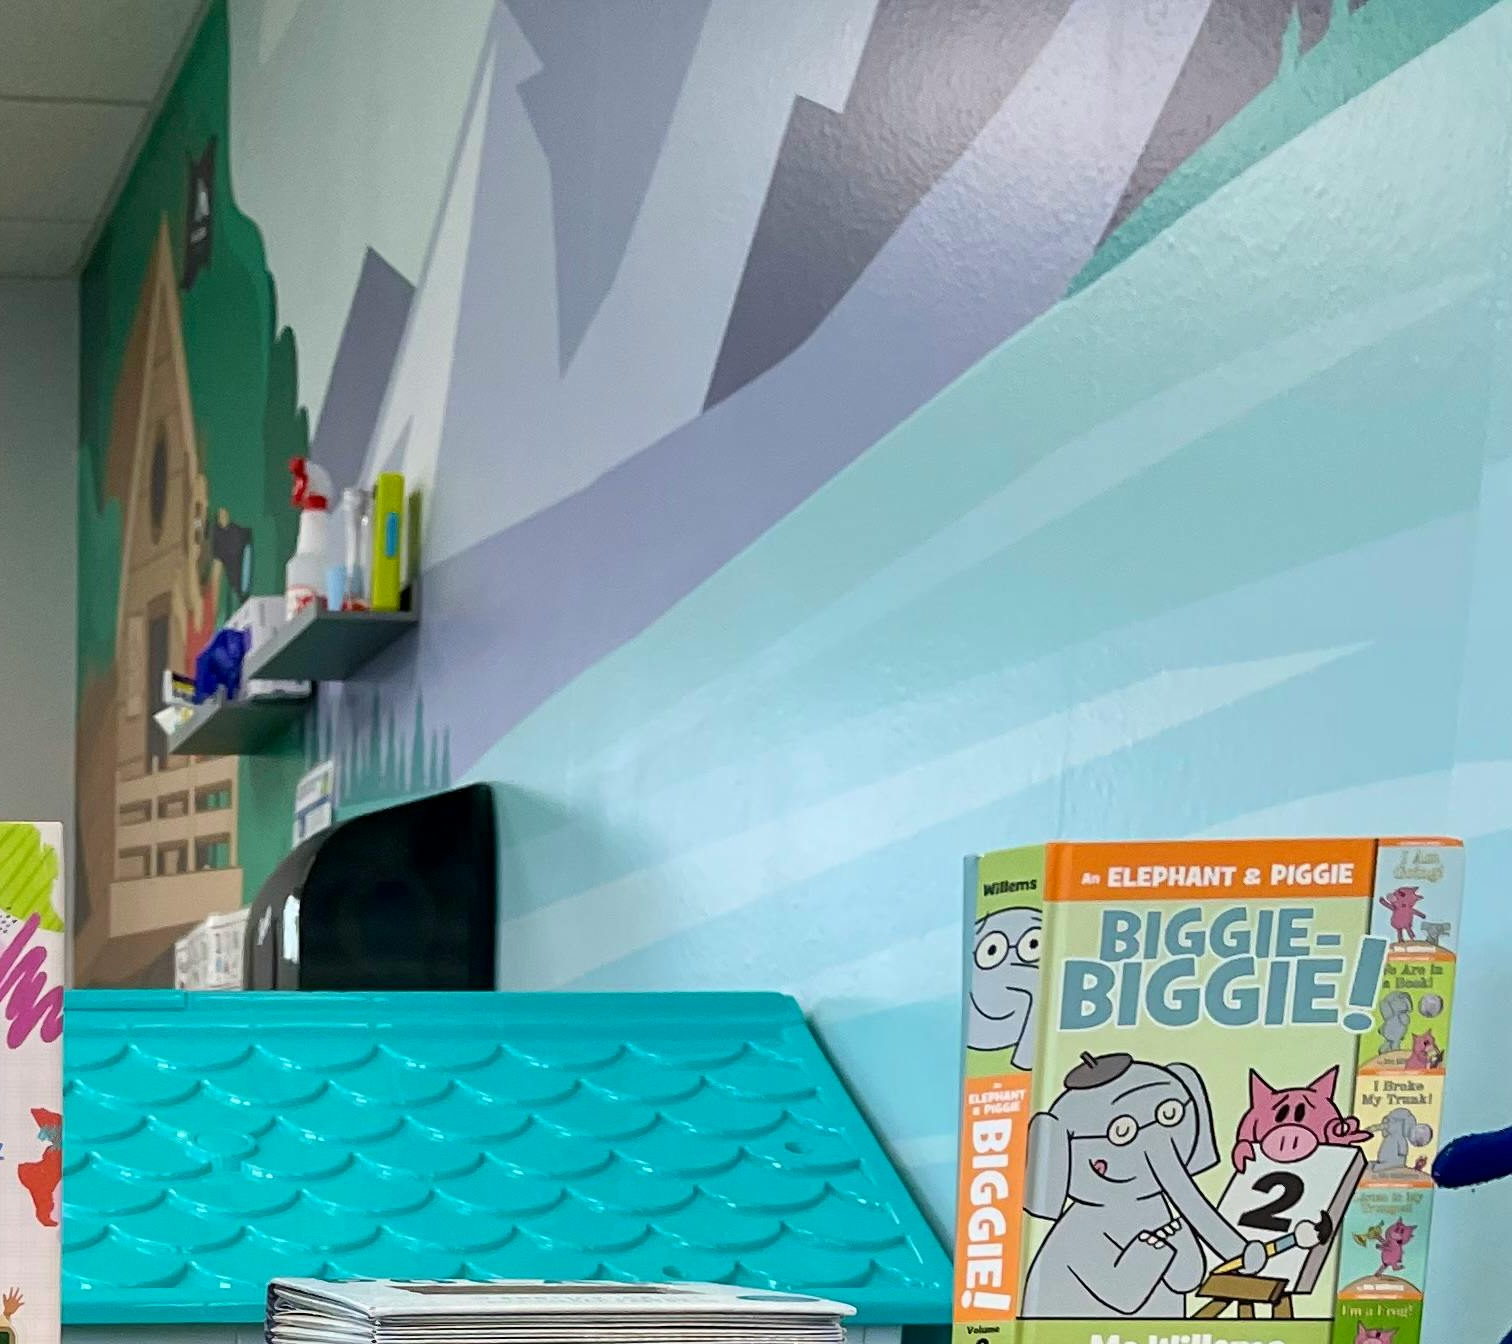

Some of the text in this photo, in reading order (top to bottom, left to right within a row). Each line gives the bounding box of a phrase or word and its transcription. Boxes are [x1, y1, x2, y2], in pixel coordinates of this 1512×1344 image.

[983, 878, 1037, 897] Willems
[1080, 862, 1356, 888] An ELEPHANT & PIGGIE
[1098, 905, 1343, 964] BIGGIE-
[1058, 935, 1389, 1033] BIGGIE!
[960, 1117, 1012, 1312] BIGGIE!
[1237, 1170, 1305, 1233] 2
